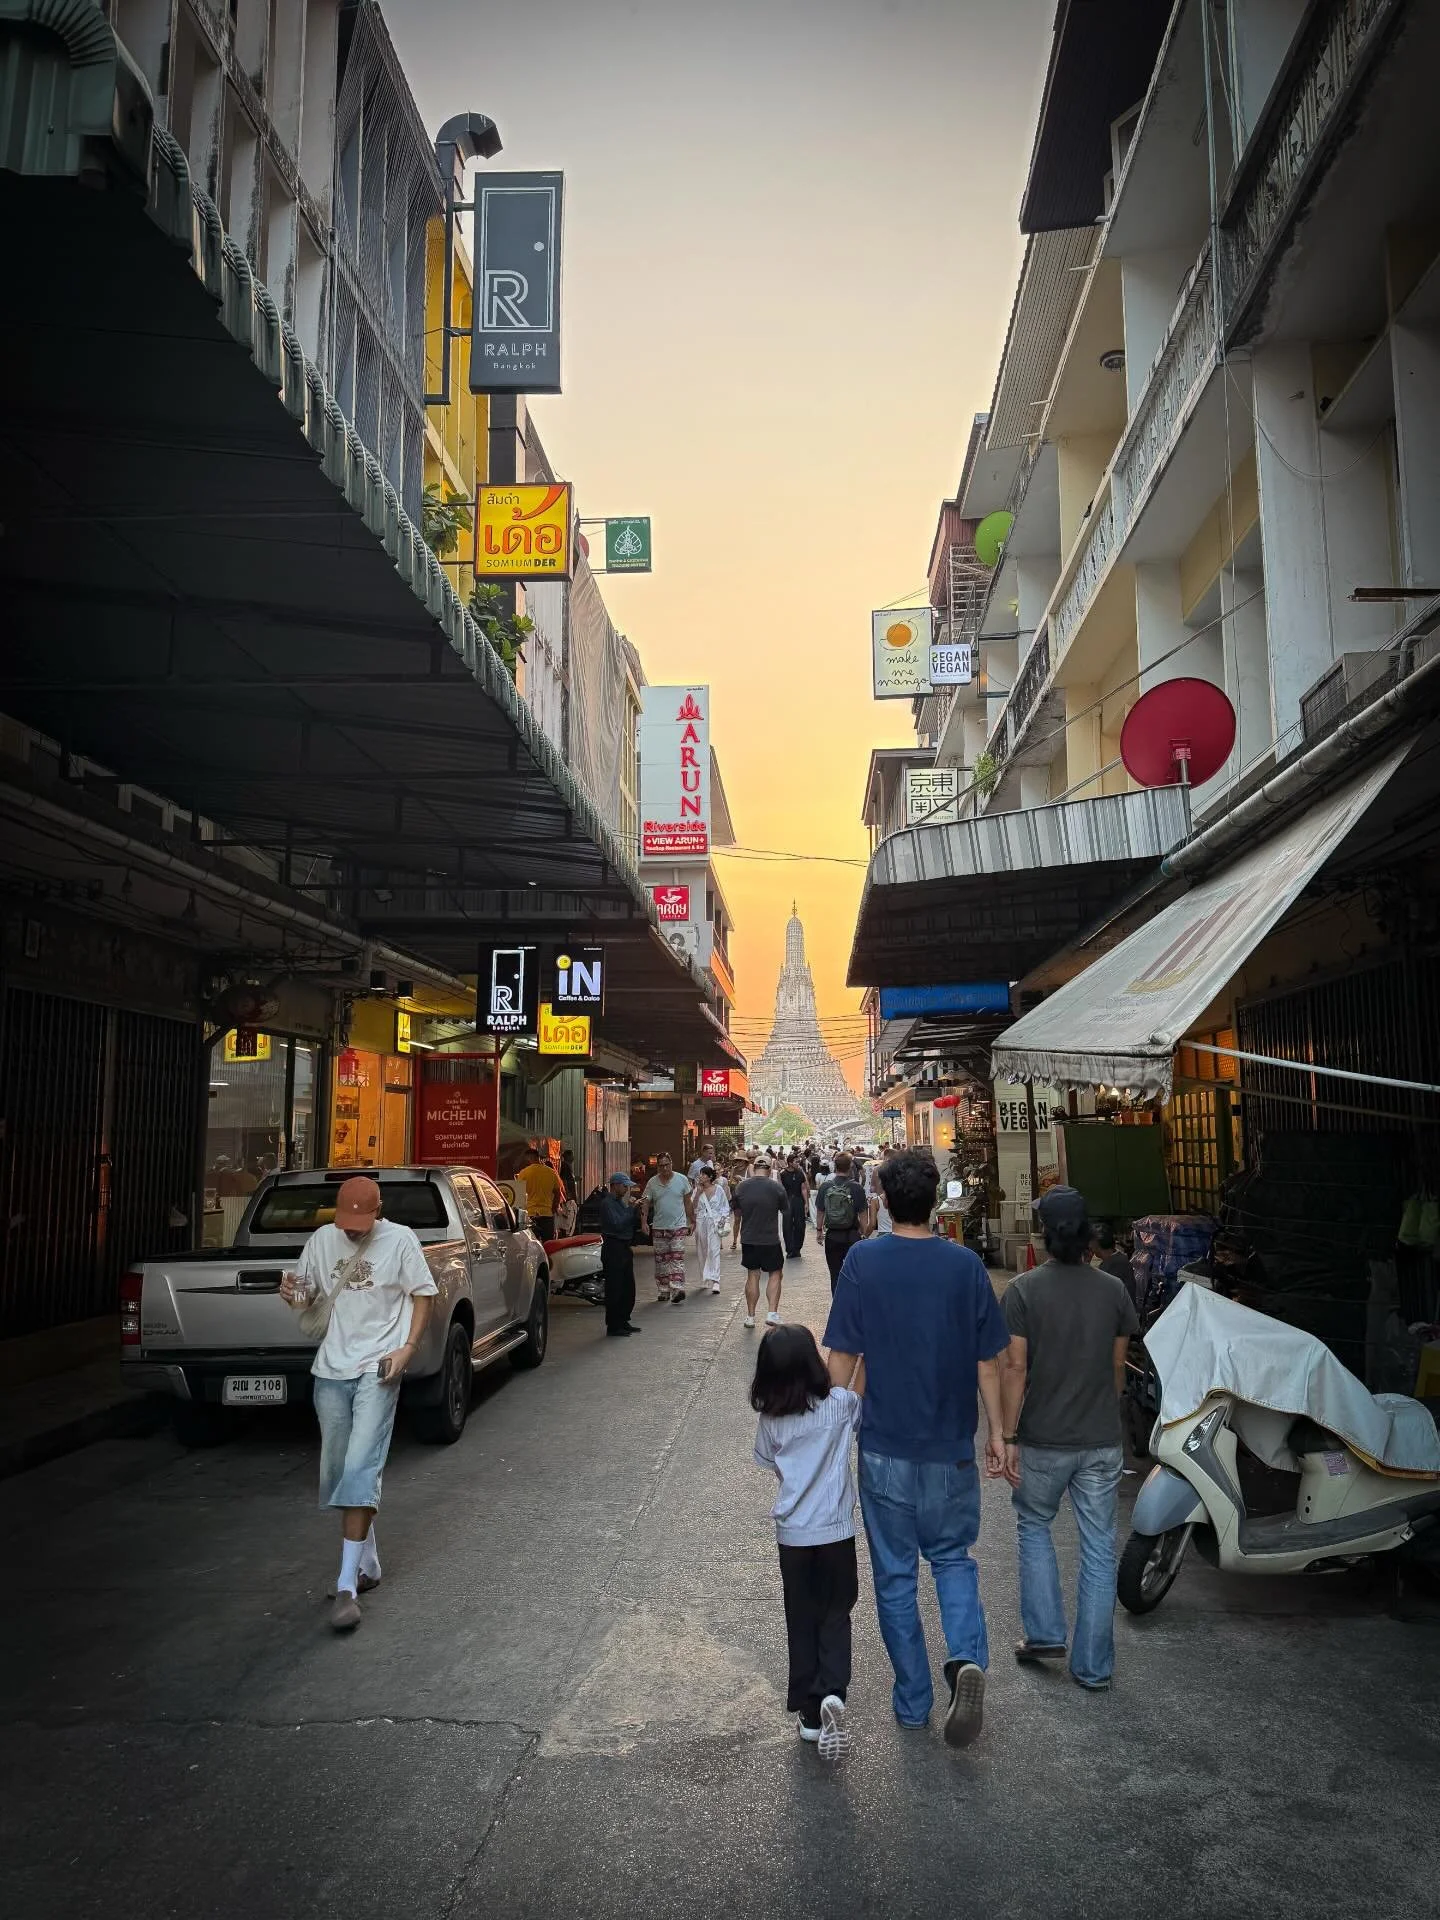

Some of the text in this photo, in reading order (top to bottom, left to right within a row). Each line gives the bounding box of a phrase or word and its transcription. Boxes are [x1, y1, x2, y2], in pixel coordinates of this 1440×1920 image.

[484, 343, 547, 357] RALPH
[493, 362, 537, 371] Bangkok
[487, 492, 520, 505] ส้มตำ
[485, 502, 562, 555] เด้อ
[886, 650, 920, 664] make
[892, 669, 915, 677] me
[932, 662, 970, 673] VEGAN
[877, 678, 930, 692] mango
[680, 722, 702, 818] ARUN
[644, 820, 706, 834] Riverside
[652, 836, 699, 845] VIEW ARUN
[656, 903, 687, 915] AROY
[486, 1015, 527, 1026] RALPH
[703, 1082, 728, 1093] AROY
[426, 1109, 487, 1121] MICHELIN
[1000, 1116, 1048, 1130] VEGN
[254, 1379, 281, 1391] 2108
